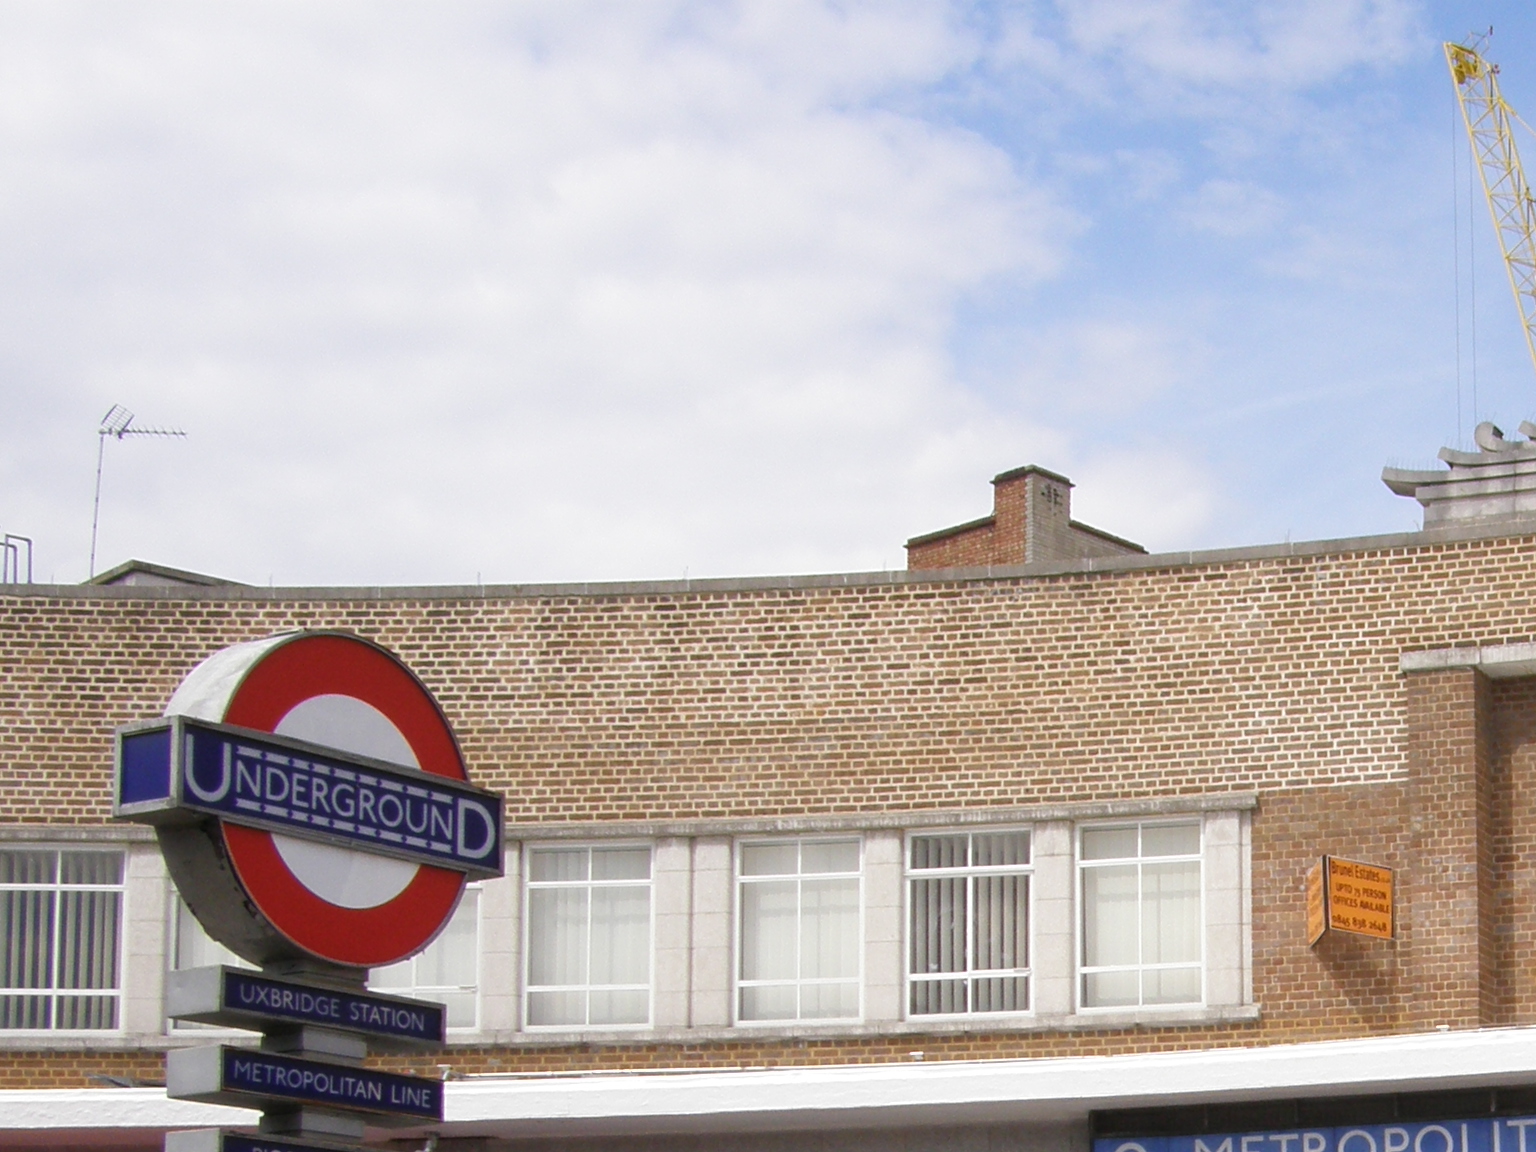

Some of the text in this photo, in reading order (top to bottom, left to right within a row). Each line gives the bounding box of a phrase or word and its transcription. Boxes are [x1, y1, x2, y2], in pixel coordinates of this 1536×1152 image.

[185, 735, 496, 860] UNDERGROUND
[1355, 865, 1380, 882] Estates
[1333, 895, 1389, 914] OFFICES AVAILABLE
[1362, 887, 1386, 900] PERSON
[241, 983, 426, 1032] UXBRIDGE STATION
[233, 1060, 432, 1109] METROPOLITAN LINE
